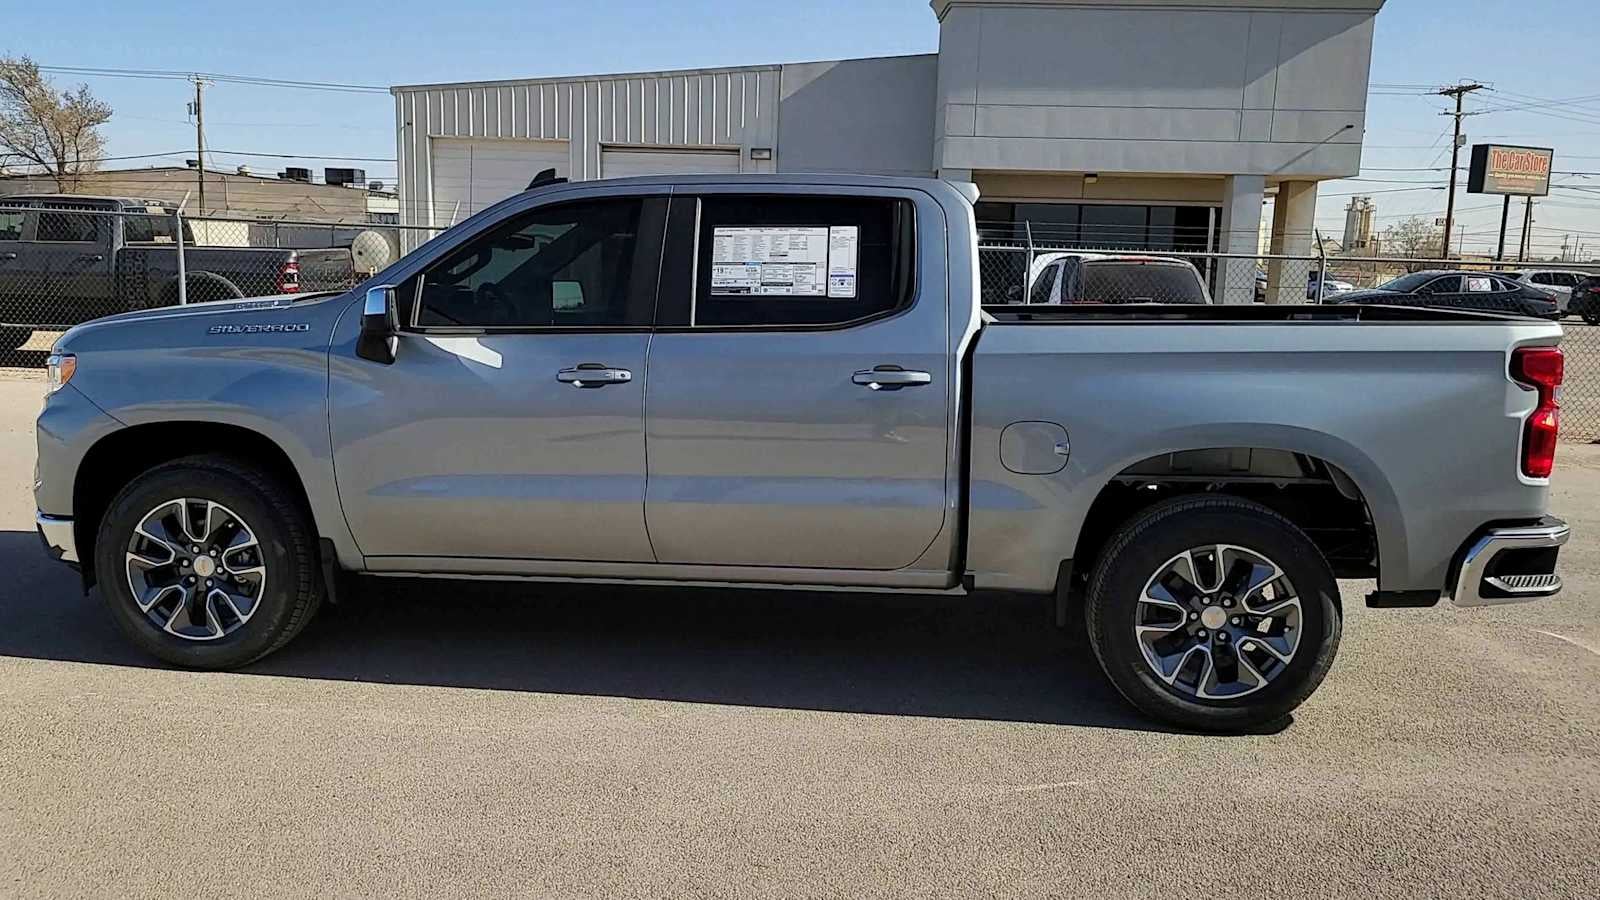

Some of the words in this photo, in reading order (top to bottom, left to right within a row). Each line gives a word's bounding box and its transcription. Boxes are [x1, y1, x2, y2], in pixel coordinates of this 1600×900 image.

[1492, 151, 1507, 169] The
[1509, 152, 1523, 171] Car
[1526, 152, 1548, 173] Store
[208, 323, 310, 334] SILVERADO
